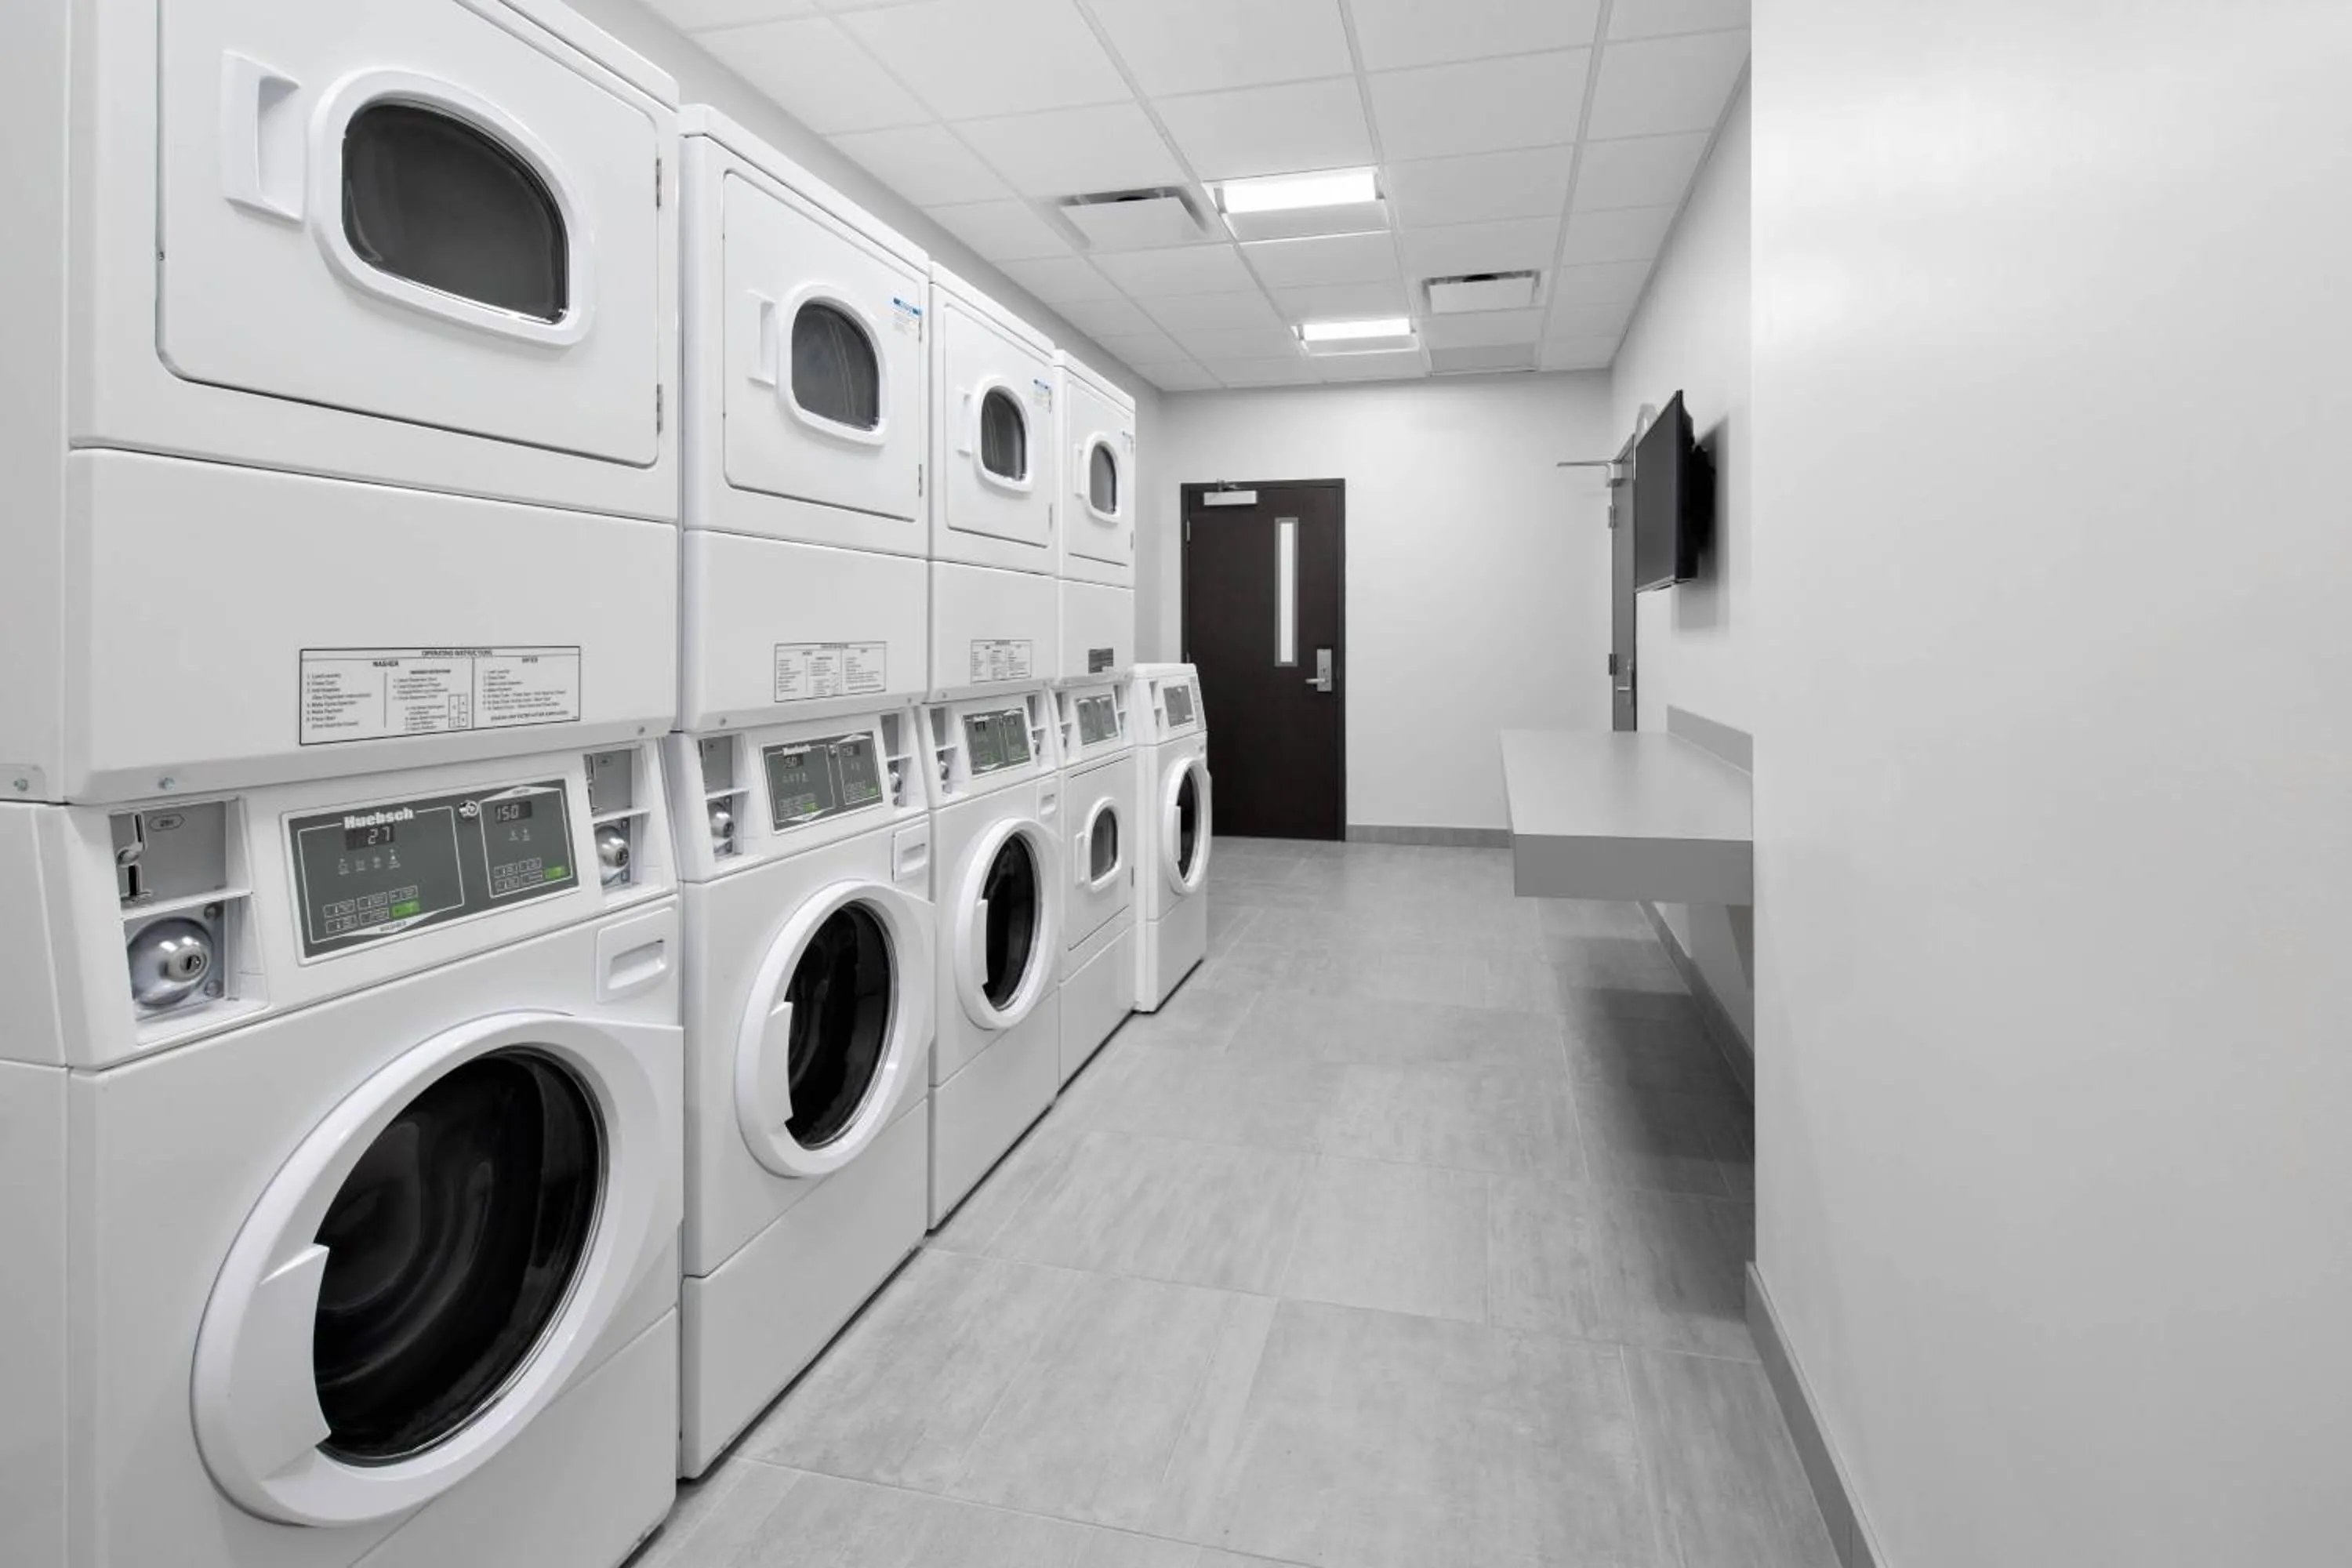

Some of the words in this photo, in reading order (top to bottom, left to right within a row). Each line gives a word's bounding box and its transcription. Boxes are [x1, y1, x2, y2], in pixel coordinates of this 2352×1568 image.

[343, 808, 414, 829] Huebsch
[496, 804, 520, 822] 150
[368, 826, 390, 845] 27
